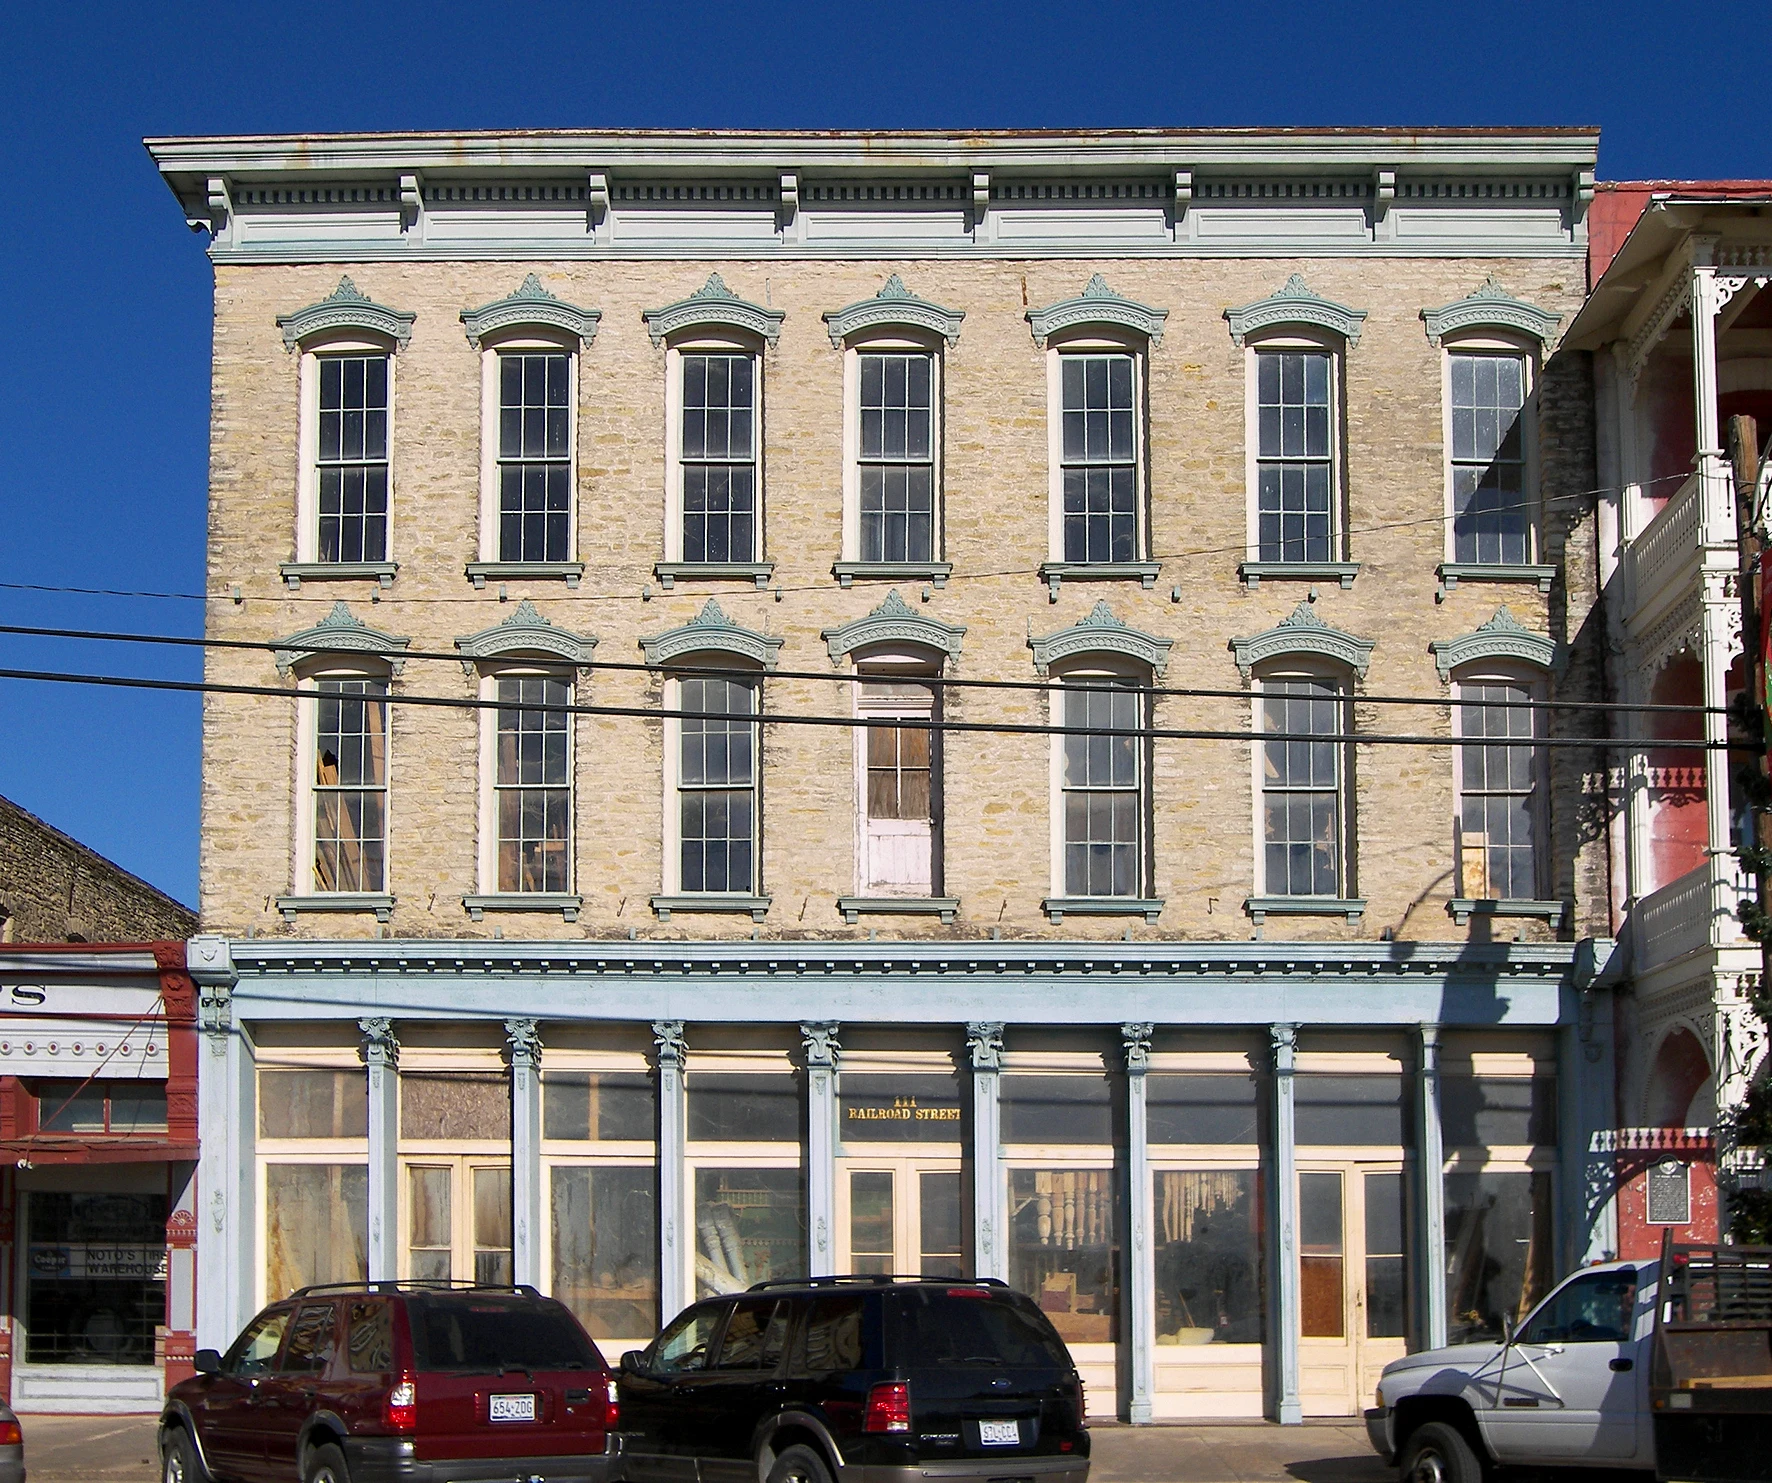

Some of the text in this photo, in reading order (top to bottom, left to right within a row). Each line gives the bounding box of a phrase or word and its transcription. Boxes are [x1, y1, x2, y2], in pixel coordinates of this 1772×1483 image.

[0, 983, 46, 1006] S
[894, 1096, 917, 1108] 111
[848, 1108, 961, 1120] RAILROAD STREET
[87, 1250, 136, 1261] NOTO'S
[87, 1263, 168, 1274] WAREHOUSE
